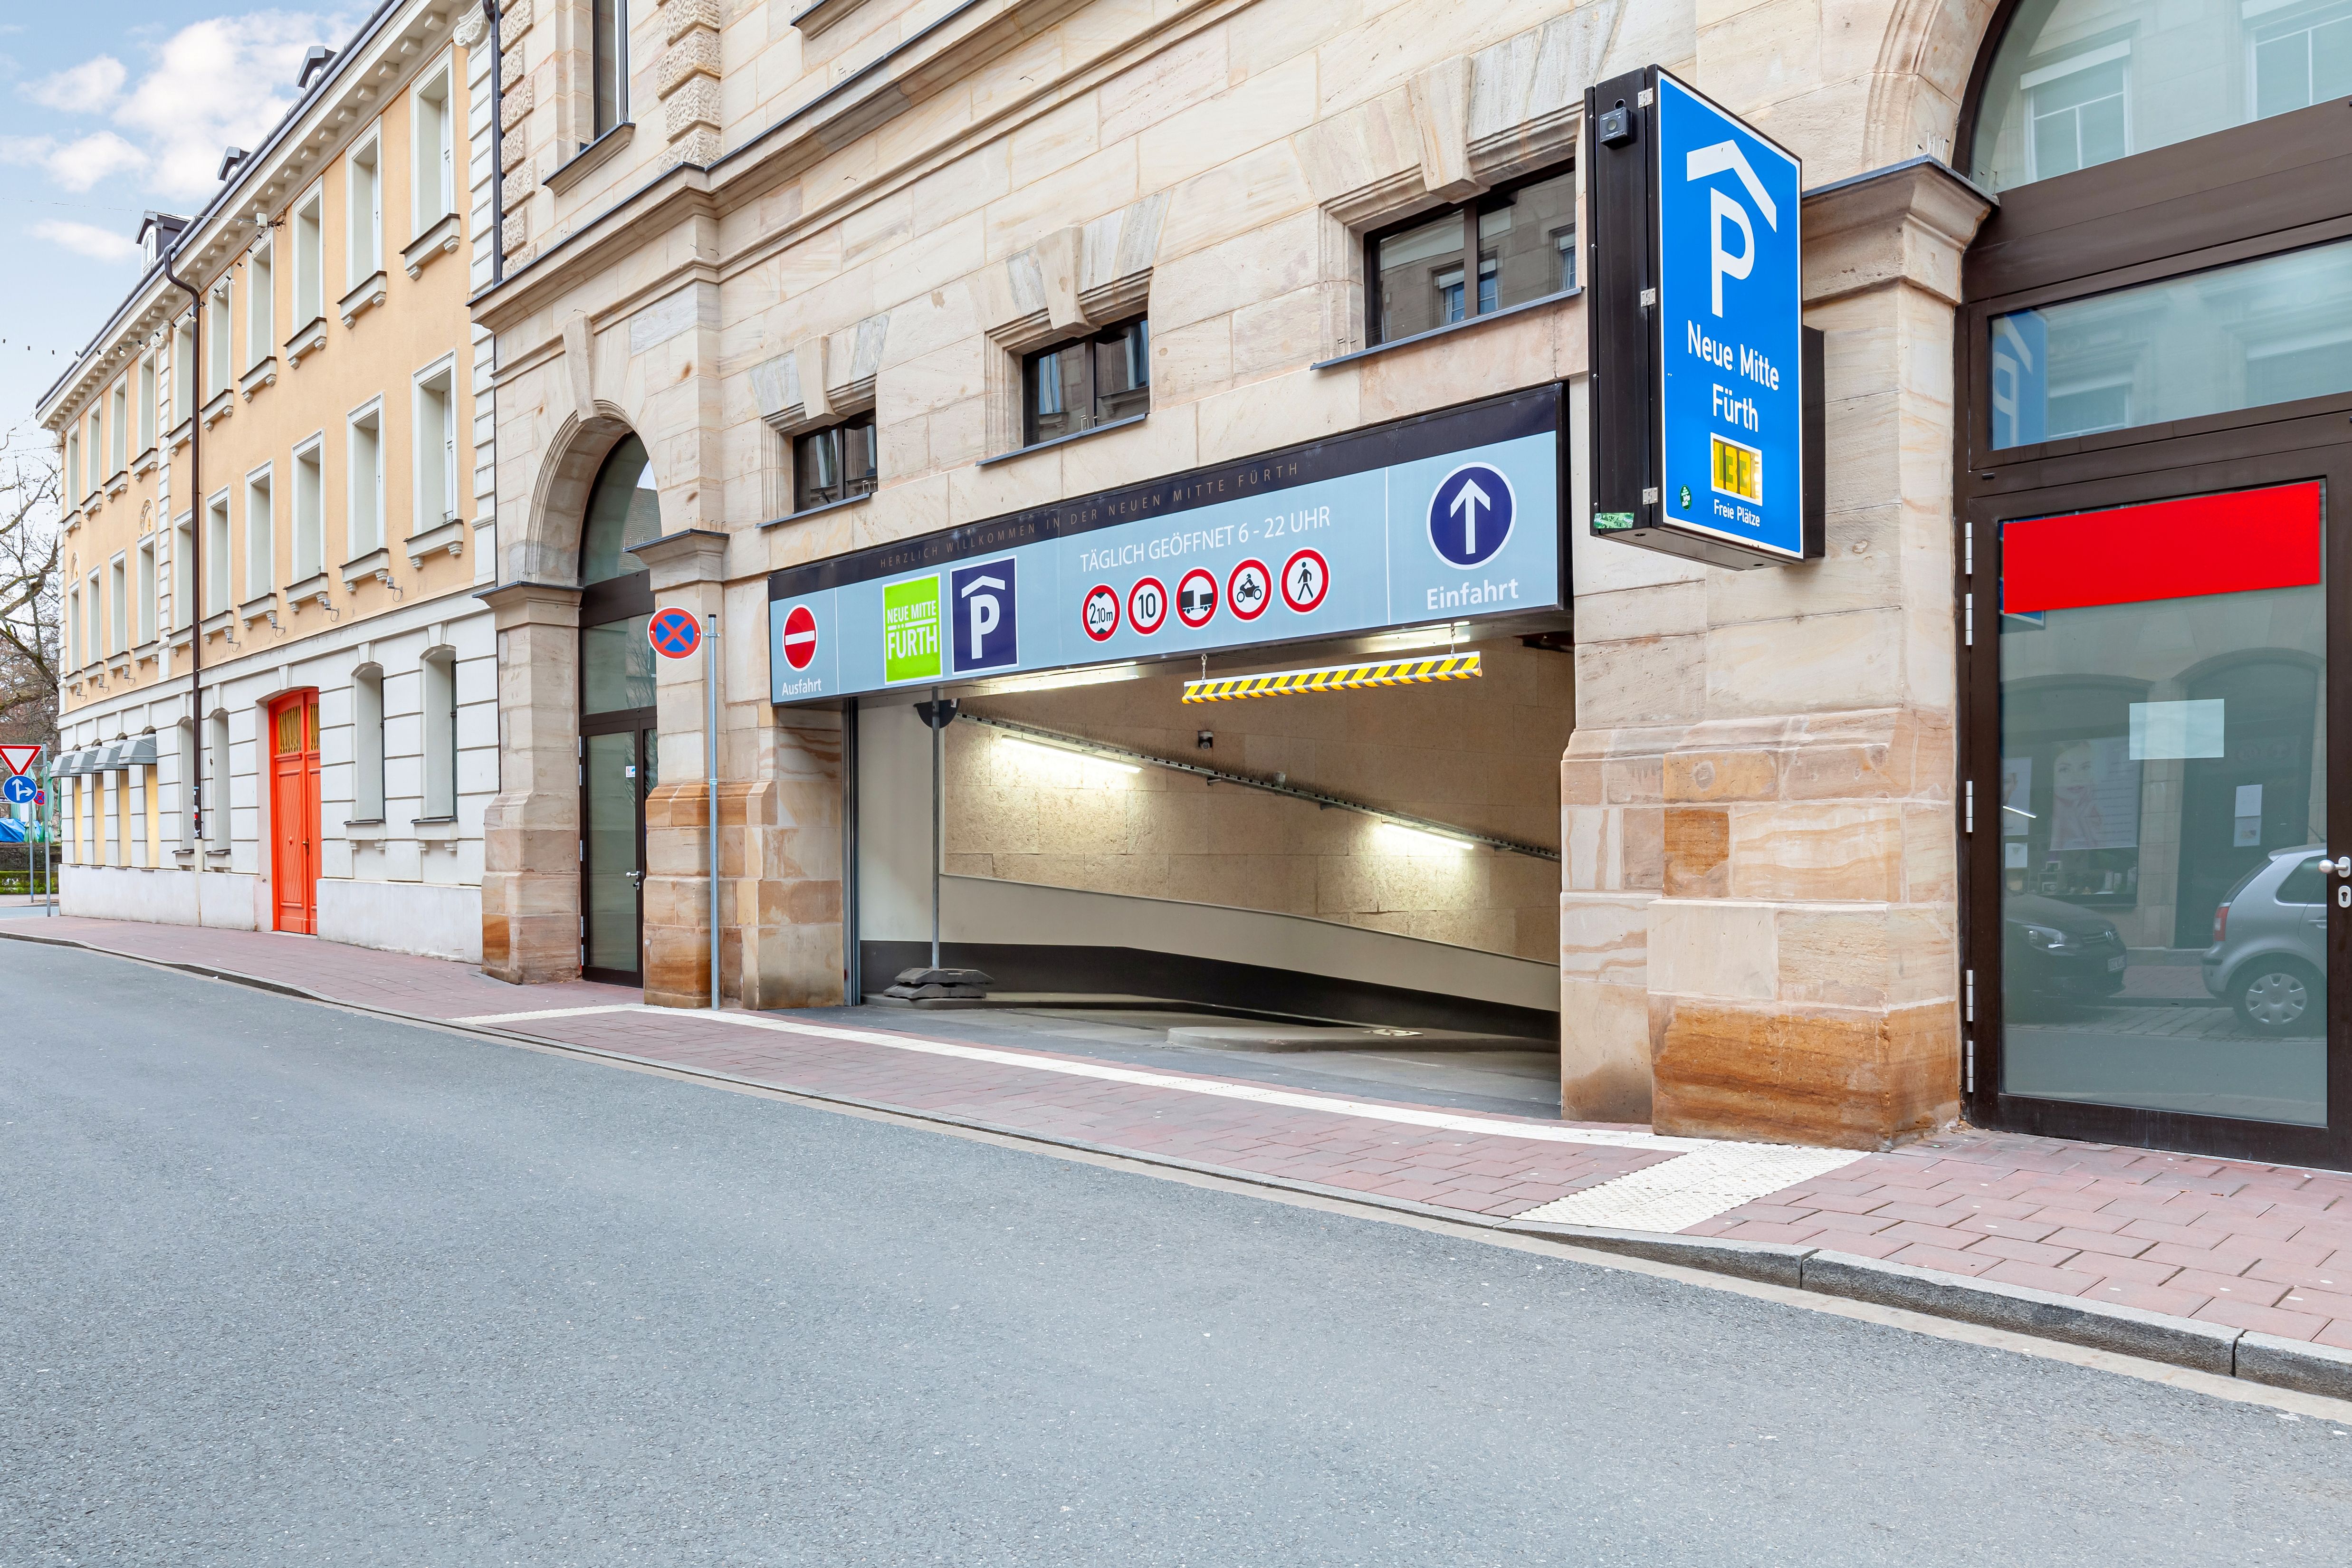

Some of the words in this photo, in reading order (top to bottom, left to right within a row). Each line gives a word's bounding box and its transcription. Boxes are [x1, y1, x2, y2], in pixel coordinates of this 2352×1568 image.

[1710, 187, 1755, 318] P
[1688, 320, 1733, 371] Neue
[1740, 344, 1779, 391] Mitte
[1713, 383, 1759, 432] Fürth
[880, 546, 937, 568] HERZLICH
[946, 523, 1034, 553] WILLKOMMEN
[1047, 516, 1060, 530] IN
[1071, 509, 1097, 525] DER
[1109, 495, 1160, 516] NEUEN
[1173, 479, 1224, 502] MITTE
[1238, 462, 1297, 487] FÜRTH
[1714, 498, 1734, 519] Freie
[1737, 506, 1760, 527] Plätze
[1080, 543, 1143, 572] TÄGLICH
[1148, 525, 1234, 559] GEÖFFNET
[1238, 523, 1249, 543] 6
[1264, 516, 1285, 538] 22
[1290, 506, 1330, 533] UHR
[887, 605, 908, 624] NEUE
[911, 600, 937, 619] MITTE
[1138, 593, 1156, 619] 10
[1427, 578, 1519, 610] Einfahrt
[888, 623, 937, 660] FÜRTH
[970, 594, 1000, 660] P
[782, 678, 822, 696] Ausfahrt
